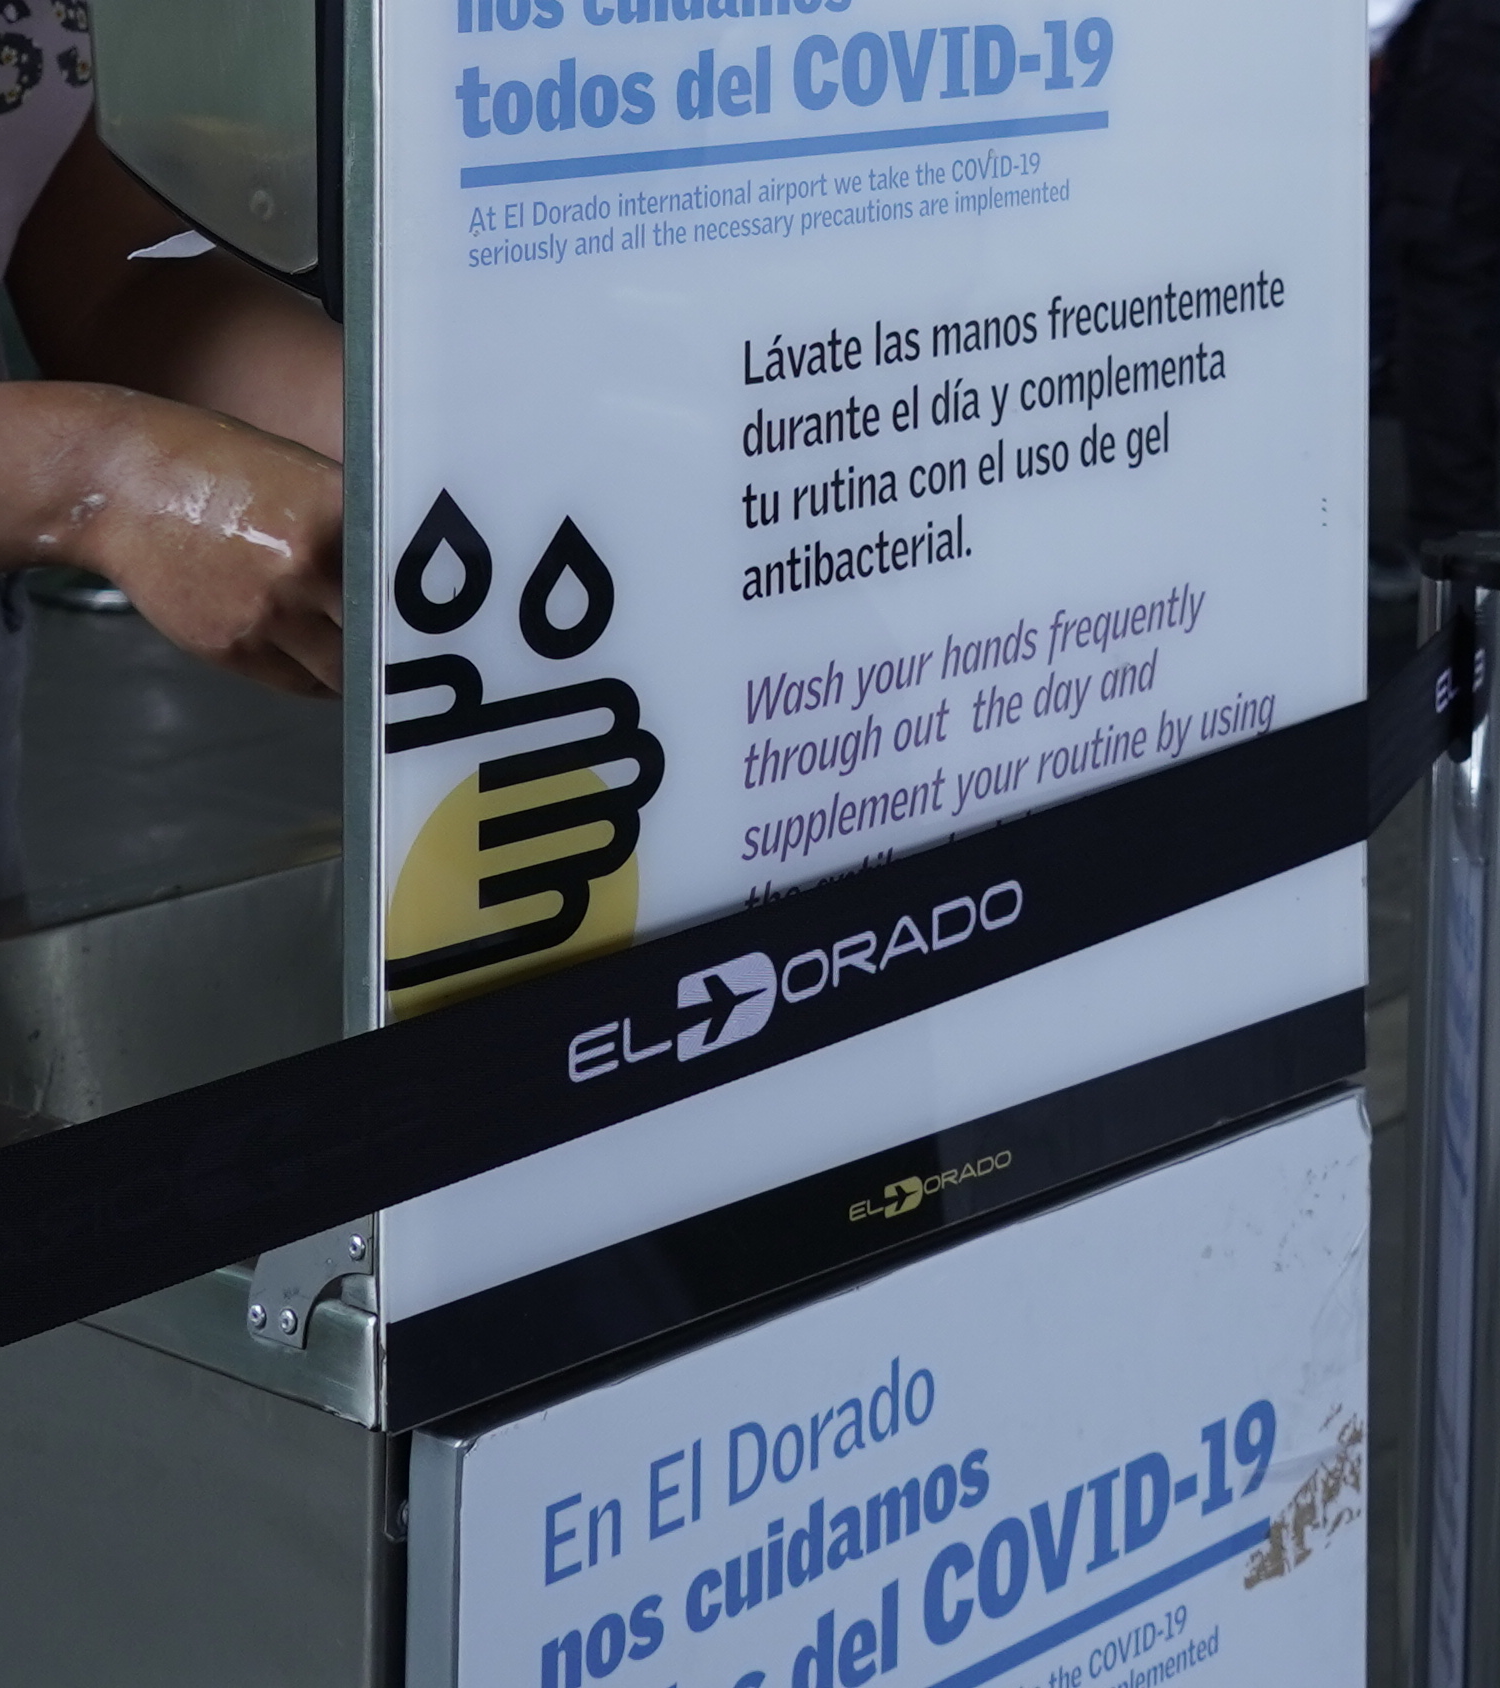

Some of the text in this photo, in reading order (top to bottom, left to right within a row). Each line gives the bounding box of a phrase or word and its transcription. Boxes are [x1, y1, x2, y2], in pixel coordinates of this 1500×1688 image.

[456, 16, 1116, 140] todos del COVID-19
[468, 151, 1042, 234] At El Dorado international airport we take the COVID-19
[468, 178, 1071, 268] seriously and all the necessary precautions are implemented
[743, 269, 1286, 386] Lávate las manos frecuentemente
[742, 341, 1227, 458] durante el día y complementa
[741, 410, 1171, 529] tu rutina con el uso de gel
[741, 513, 973, 602] antibacterial.
[744, 581, 1206, 725] Wash your hands frequently
[740, 766, 946, 864] supplement
[951, 753, 1029, 817] your
[1036, 722, 1147, 785] routine
[1155, 708, 1193, 760] by
[1200, 691, 1277, 741] using
[742, 646, 1160, 790] through out the day and
[545, 1356, 937, 1587] En El Dorado
[540, 1447, 990, 1688] nos cuidamos
[791, 1398, 1278, 1688] del COVID-19
[1088, 1604, 1188, 1679] COVID-19
